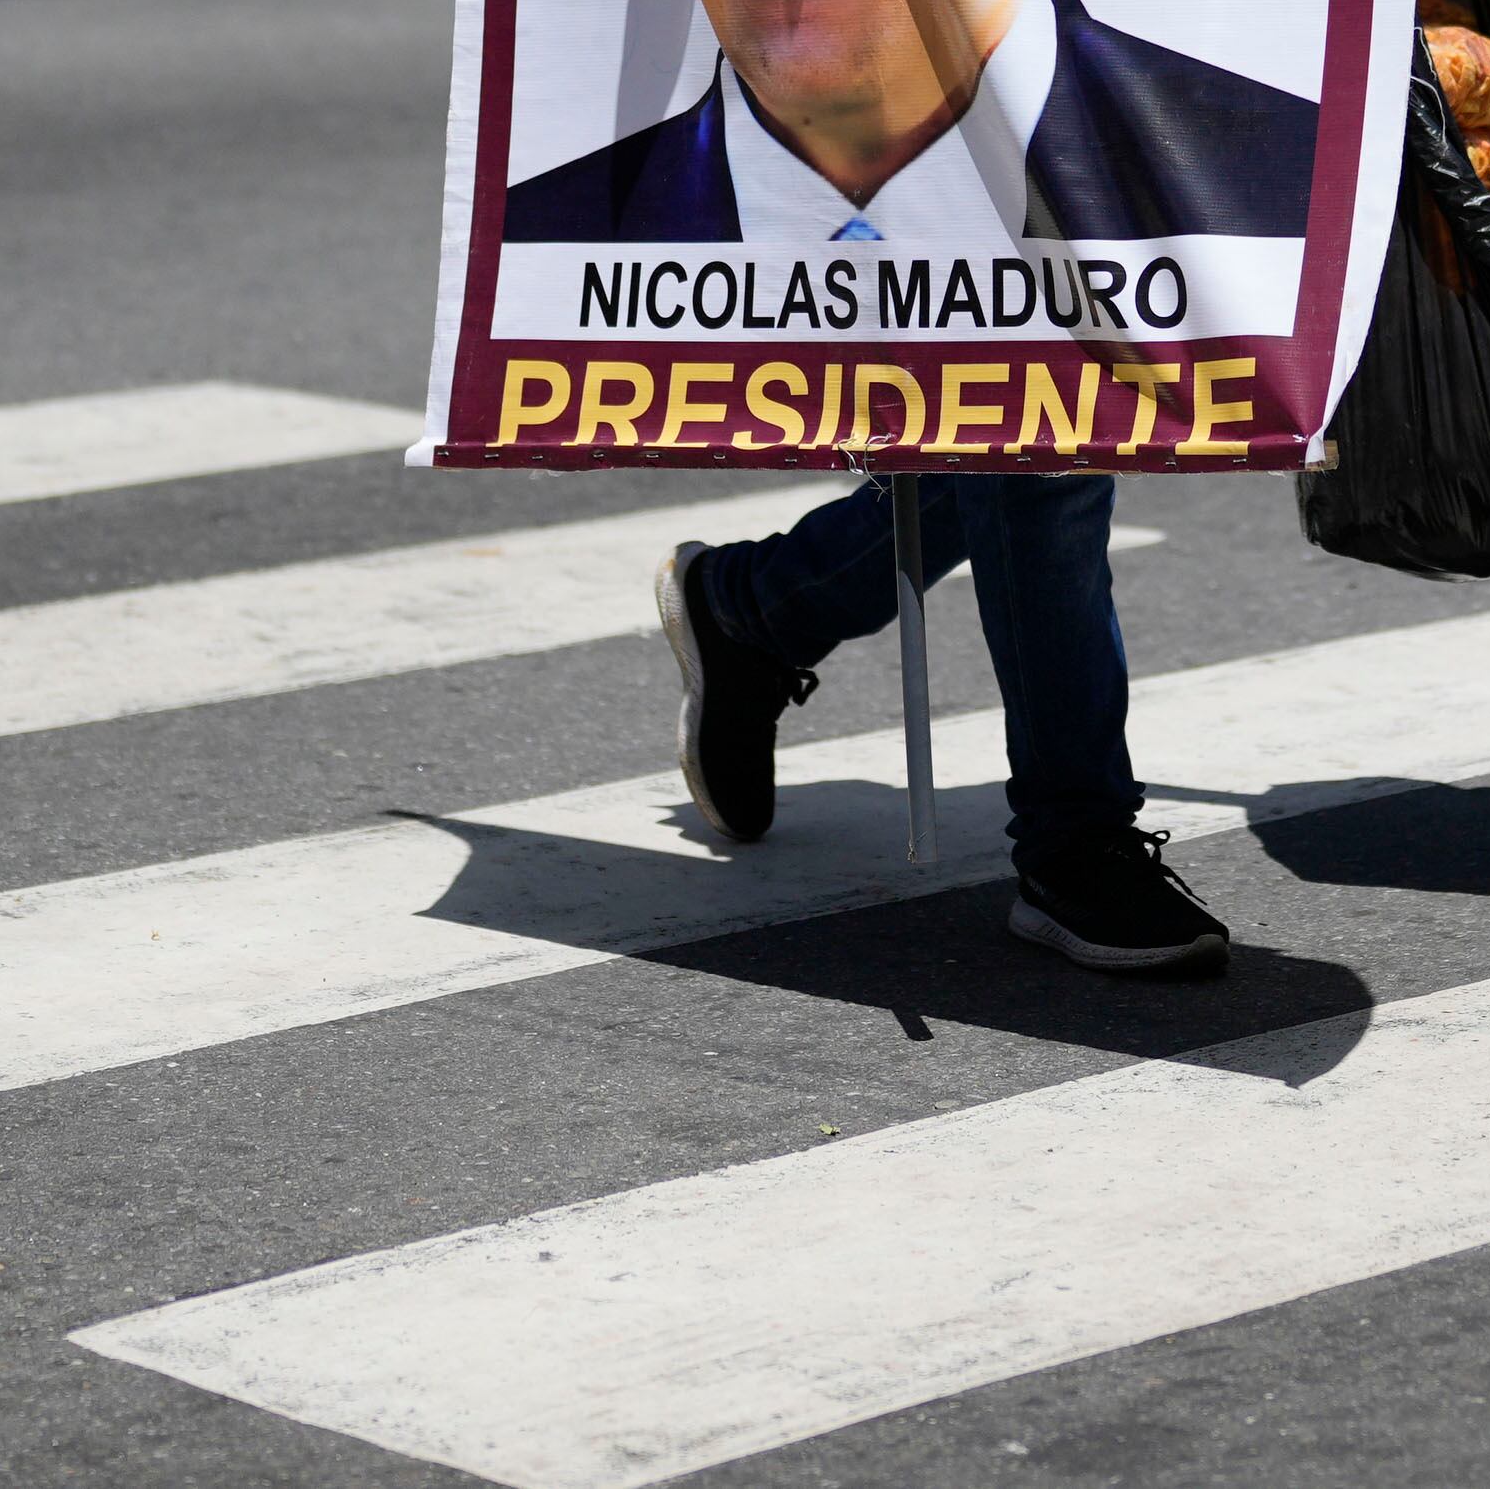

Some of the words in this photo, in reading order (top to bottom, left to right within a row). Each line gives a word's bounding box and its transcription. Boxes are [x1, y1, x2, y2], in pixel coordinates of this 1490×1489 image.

[579, 259, 859, 330] NICOLAS
[878, 256, 1189, 331] MADURO
[485, 357, 1256, 456] PRESIDENTE
